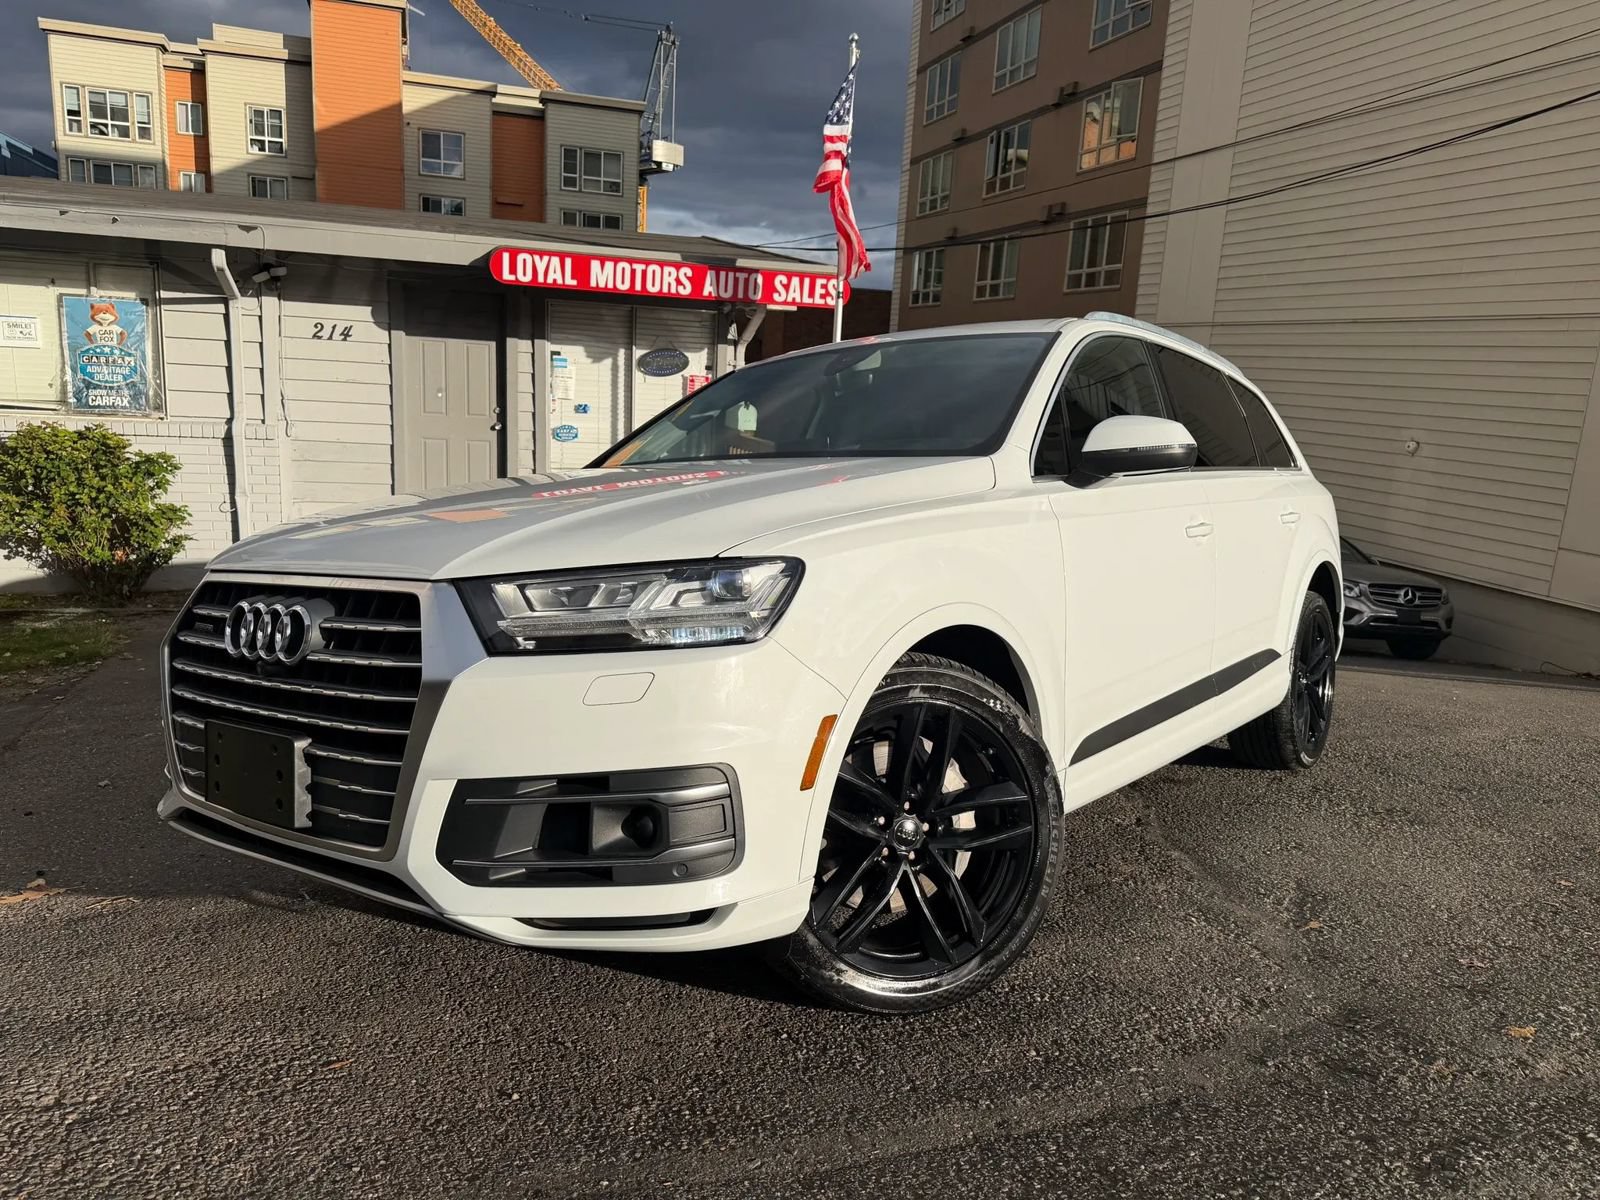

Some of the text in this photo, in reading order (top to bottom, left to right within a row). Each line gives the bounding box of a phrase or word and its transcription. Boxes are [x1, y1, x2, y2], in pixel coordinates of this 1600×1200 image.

[502, 252, 838, 305] LOYAL MOTORS AUTO SALES
[311, 321, 354, 342] 214
[99, 335, 115, 343] FOX
[82, 354, 135, 366] CARFAX
[94, 373, 124, 382] DEALER
[88, 395, 130, 407] CARFAX
